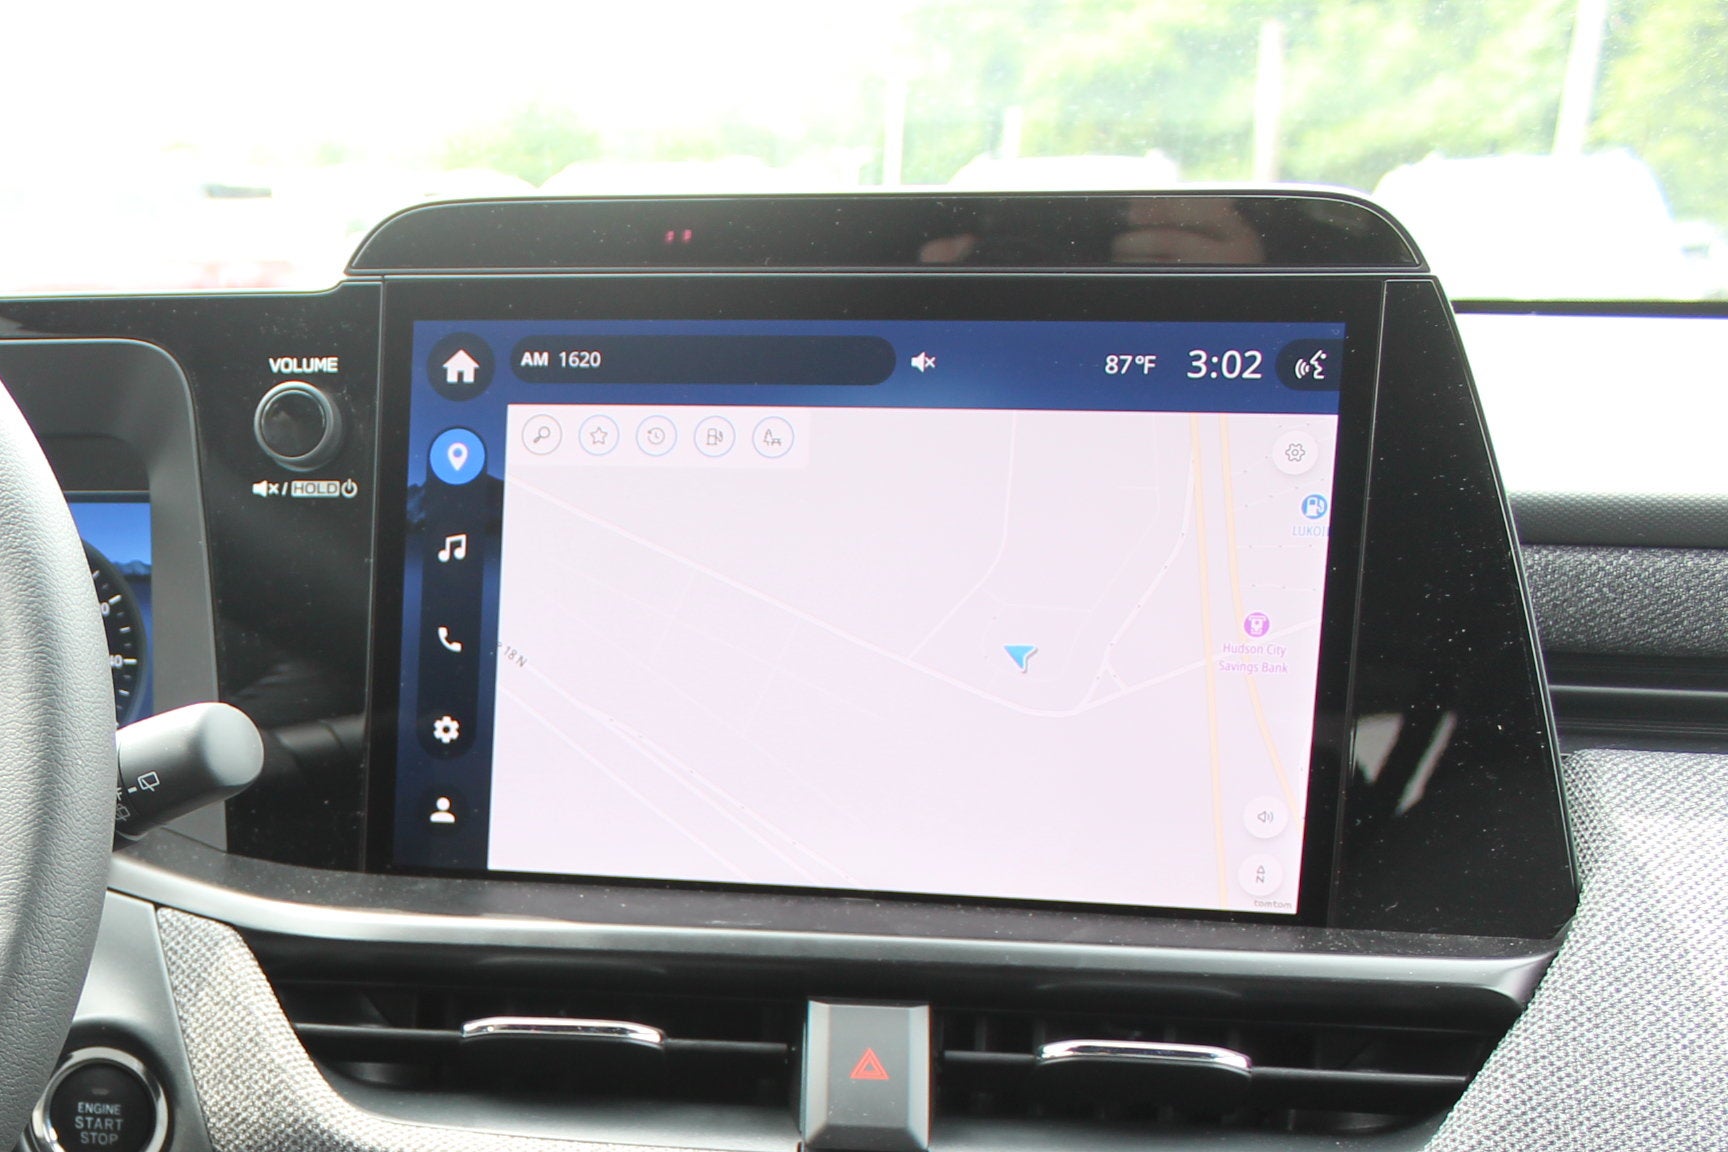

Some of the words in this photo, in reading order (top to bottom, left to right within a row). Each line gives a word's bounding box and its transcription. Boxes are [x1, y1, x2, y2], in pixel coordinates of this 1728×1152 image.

[269, 357, 339, 374] VOLUME
[520, 351, 549, 367] AM
[558, 351, 602, 368] 1620
[1187, 350, 1263, 379] 3:02
[292, 482, 340, 496] HOLD
[1292, 525, 1329, 538] LUKOI
[1223, 643, 1264, 655] Hudson
[1266, 644, 1287, 658] City
[1219, 660, 1259, 675] Savings
[1261, 661, 1288, 673] Bank
[1254, 899, 1292, 909] tomtom
[78, 1102, 121, 1115] ENGINE
[75, 1117, 122, 1131] START
[80, 1131, 119, 1145] STOP
